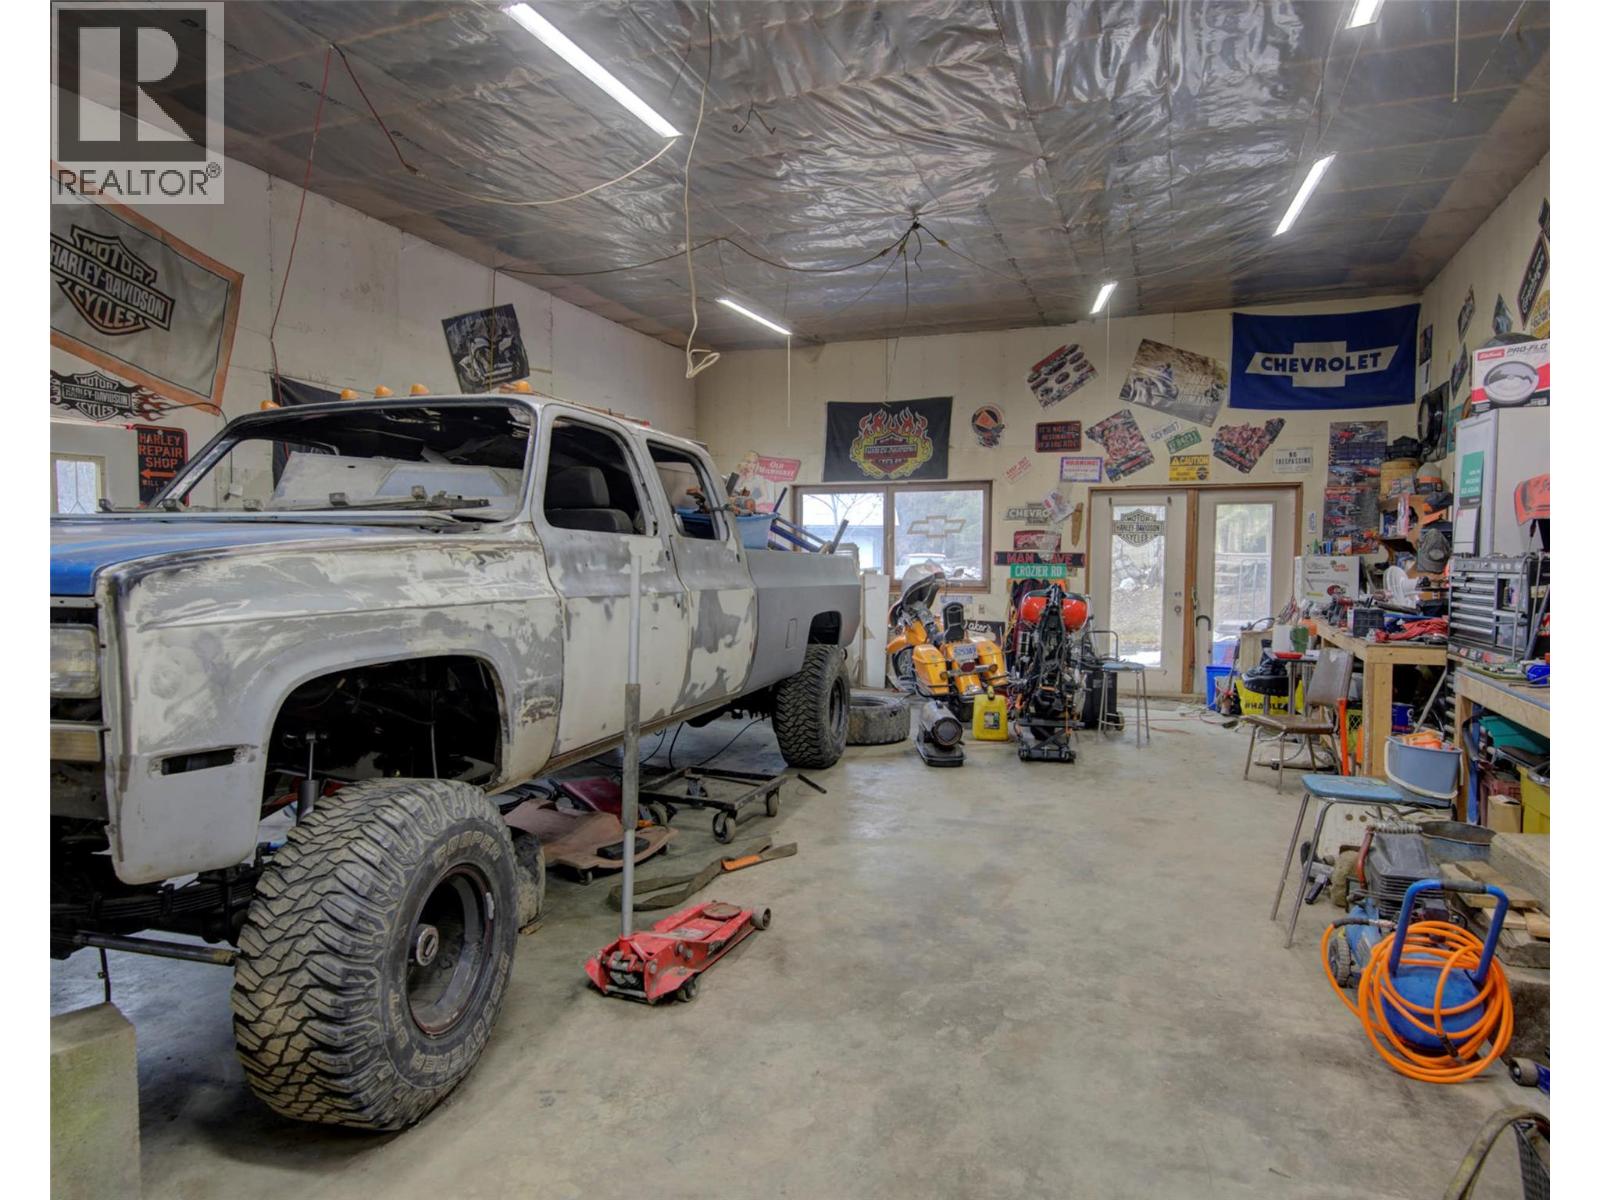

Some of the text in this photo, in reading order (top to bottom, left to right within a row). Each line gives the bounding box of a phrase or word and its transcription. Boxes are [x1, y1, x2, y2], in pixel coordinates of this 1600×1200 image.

[82, 239, 146, 282] MOTOR
[76, 285, 136, 327] CYCLES
[1260, 351, 1382, 373] CHEVROLET
[81, 376, 114, 390] MOTOR
[65, 386, 129, 405] HARLEY-DAVIDSON
[81, 403, 114, 417] CYCLES
[139, 433, 181, 446] HARLEY
[138, 445, 183, 457] REPAIR
[145, 457, 178, 469] SHOP
[1180, 455, 1209, 466] CAUTION
[1008, 509, 1051, 518] CHEVRO
[1006, 553, 1035, 564] MAN
[1014, 565, 1063, 577] CROZIER RD
